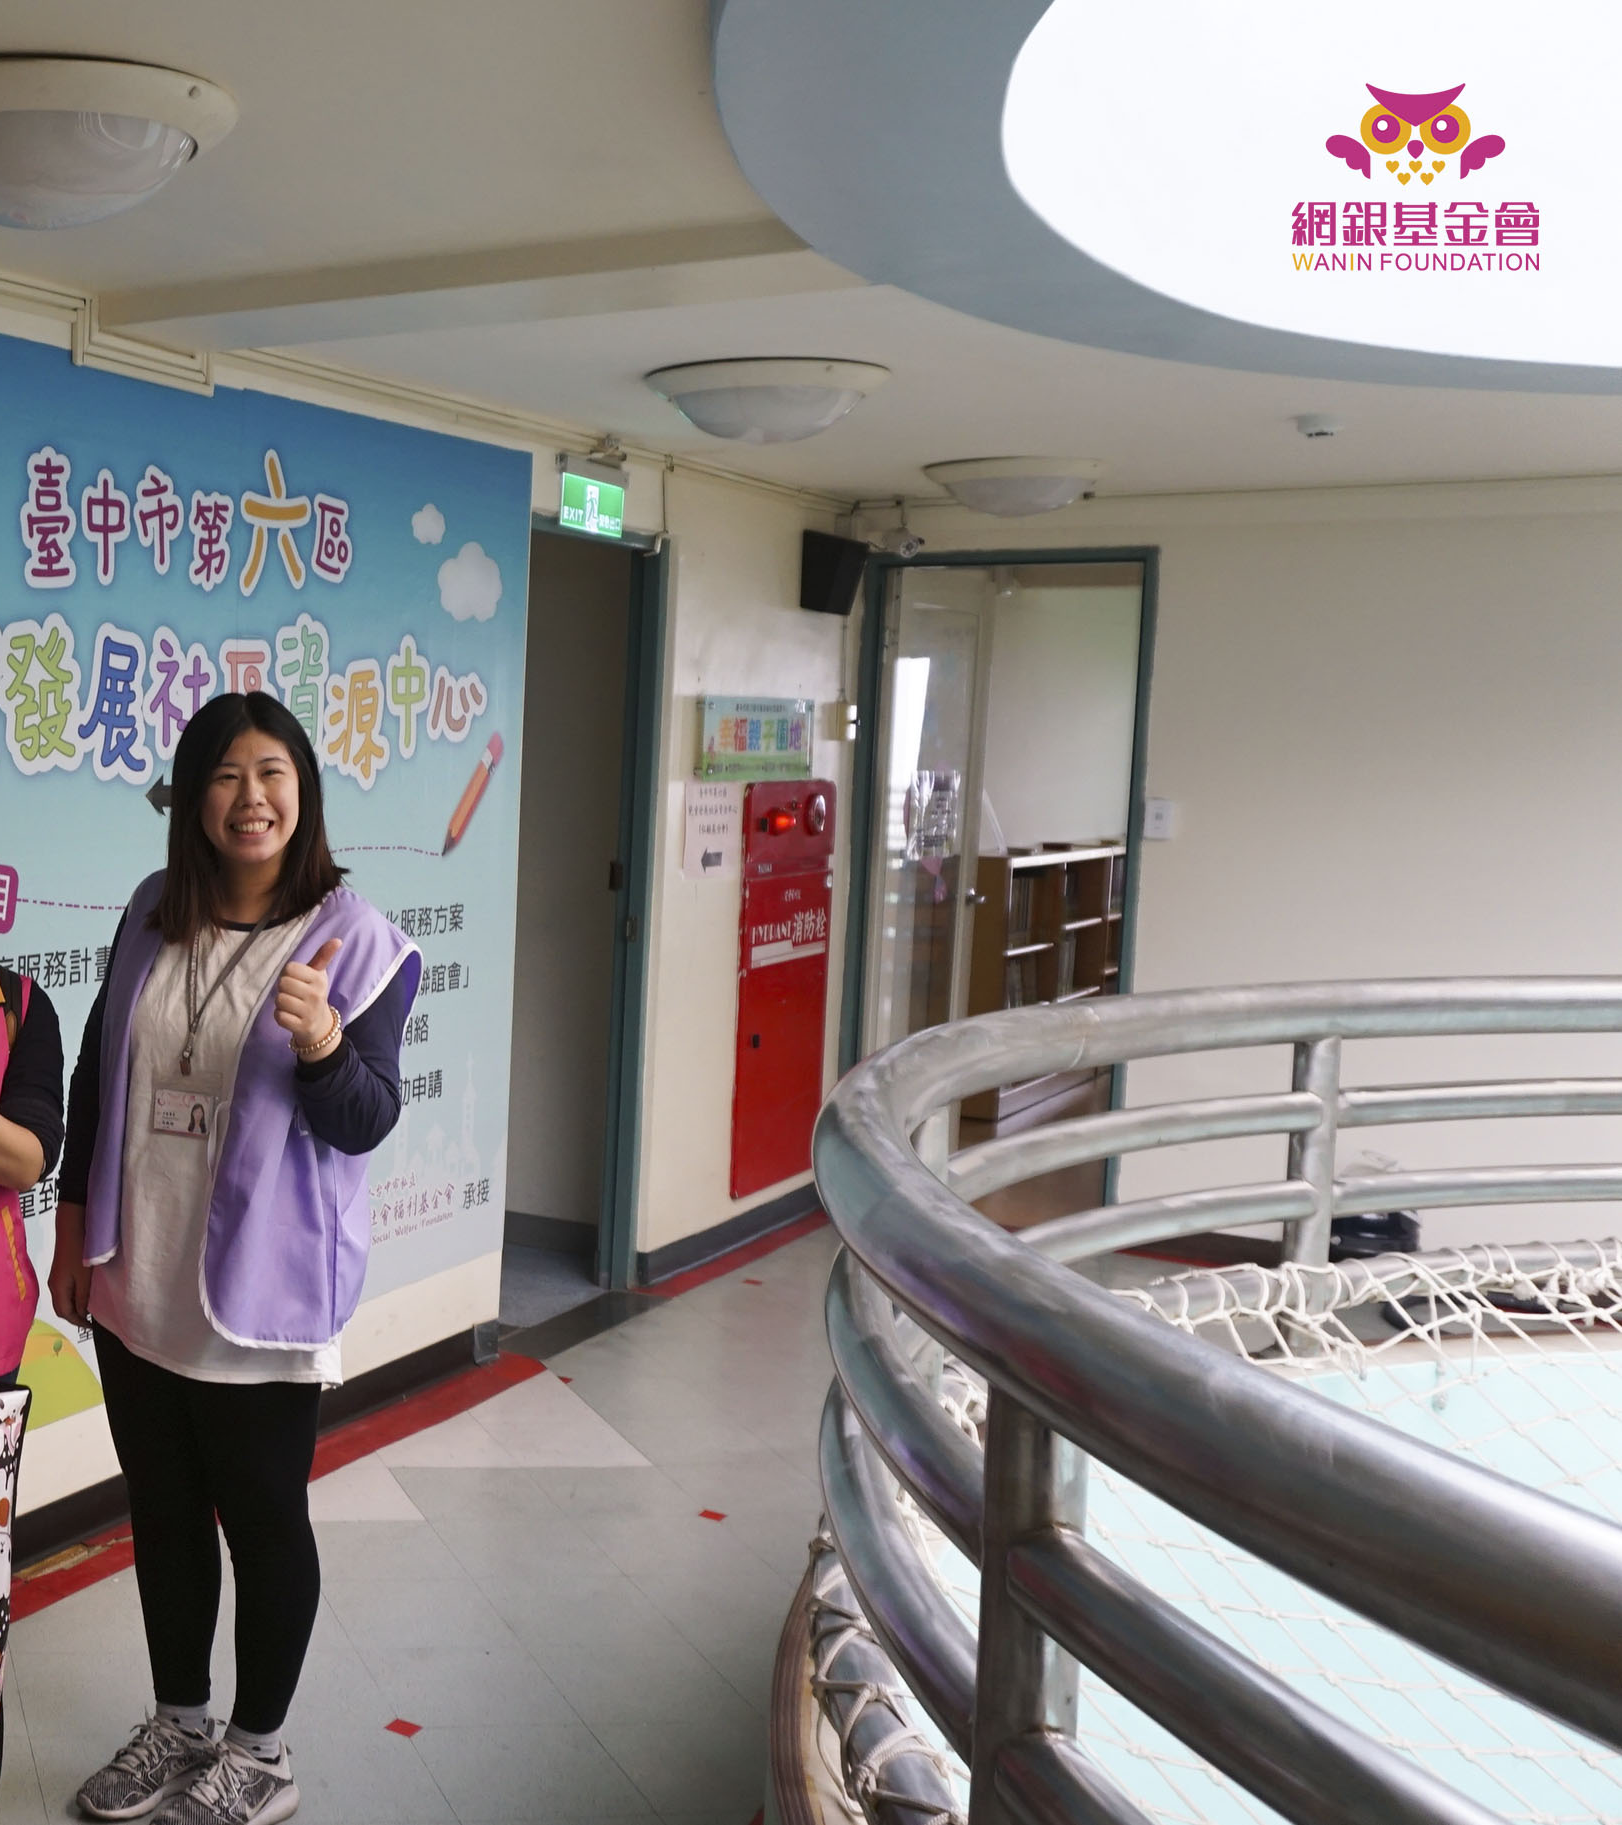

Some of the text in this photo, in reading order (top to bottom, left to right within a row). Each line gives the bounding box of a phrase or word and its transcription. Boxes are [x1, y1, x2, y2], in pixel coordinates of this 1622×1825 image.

[28, 448, 350, 590] 臺中市第六區
[563, 505, 584, 522] EXIT
[793, 907, 827, 943] 消防栓
[462, 1178, 490, 1210] 承接
